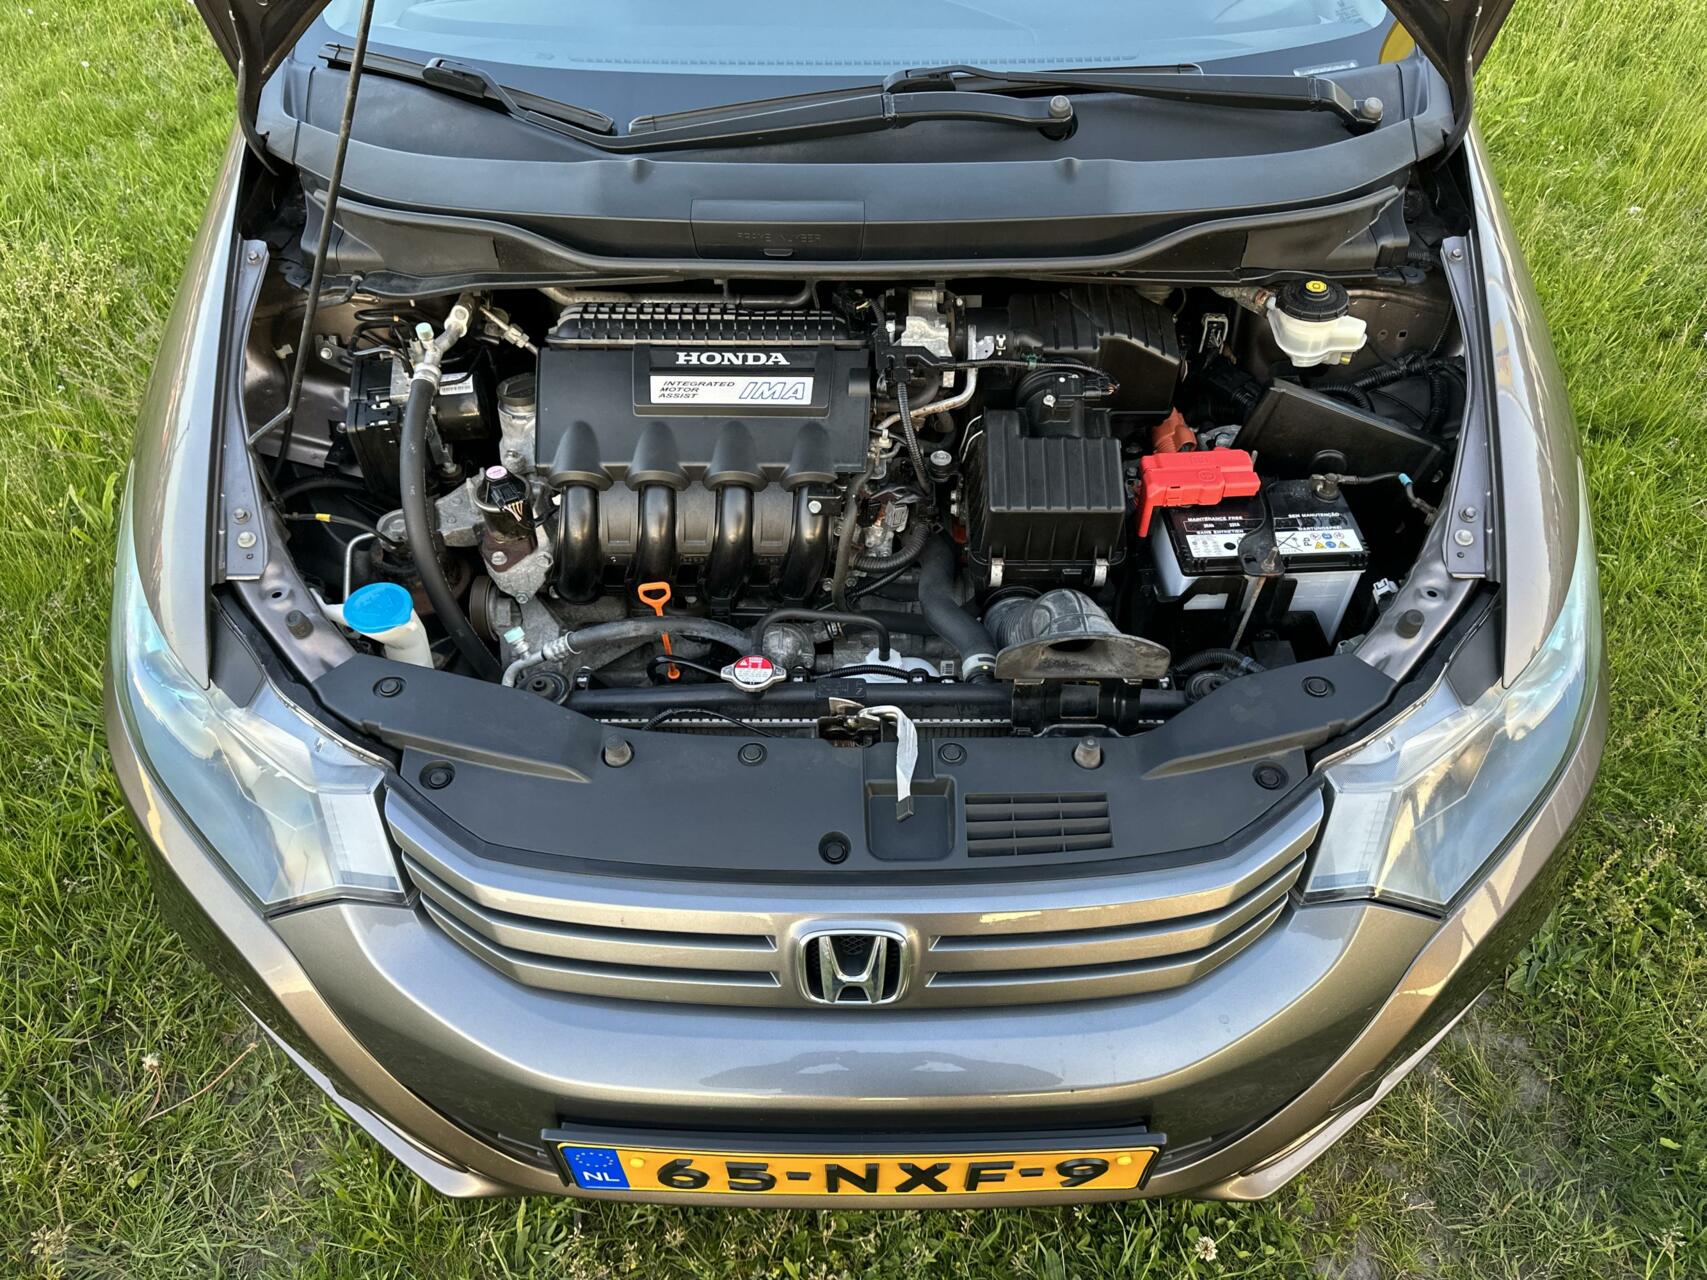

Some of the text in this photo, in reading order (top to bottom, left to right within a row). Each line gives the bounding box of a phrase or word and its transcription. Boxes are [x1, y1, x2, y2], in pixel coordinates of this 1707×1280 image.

[675, 352, 790, 365] HONDA
[663, 380, 736, 388] INTEGRATED
[739, 382, 805, 400] IMA
[582, 1170, 621, 1183] NL
[656, 1157, 1110, 1194] 65-NXF-9
